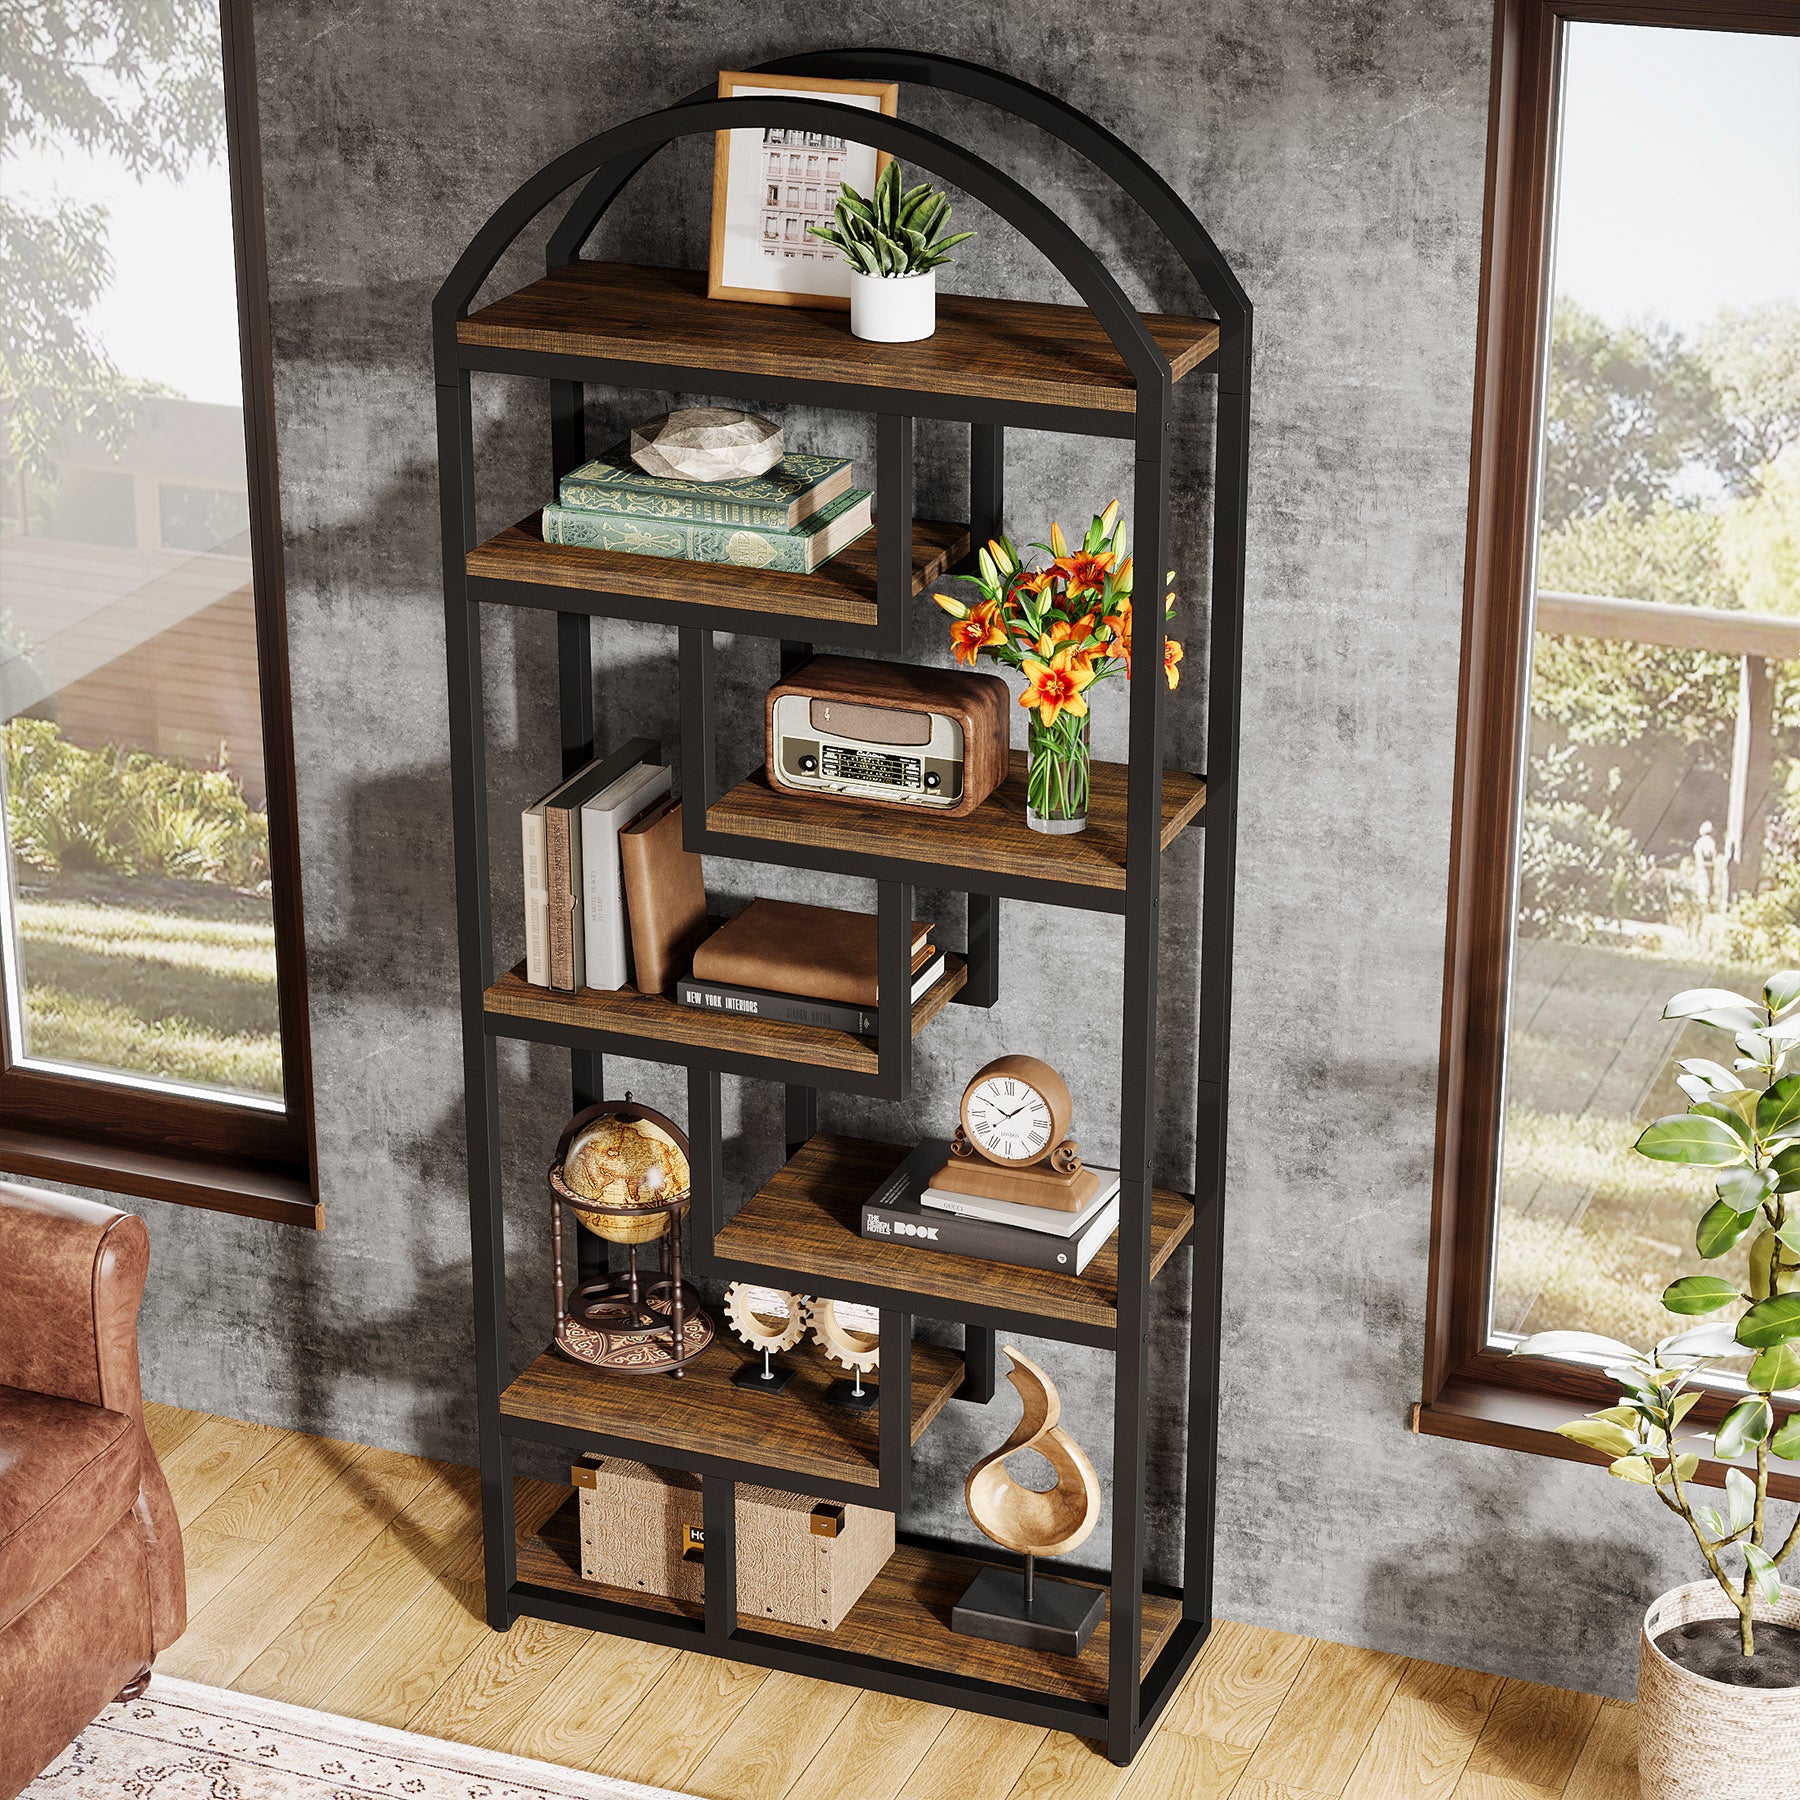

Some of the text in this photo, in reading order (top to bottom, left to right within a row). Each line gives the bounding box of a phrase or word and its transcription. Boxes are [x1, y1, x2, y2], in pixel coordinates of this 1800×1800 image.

[686, 990, 758, 1014] NEW YORK INTERIORS
[943, 1203, 964, 1212] GUCCI
[867, 1214, 880, 1222] THE
[867, 1219, 890, 1230] DESIGN
[867, 1226, 891, 1235] HOTELS
[894, 1221, 939, 1241] BOOK
